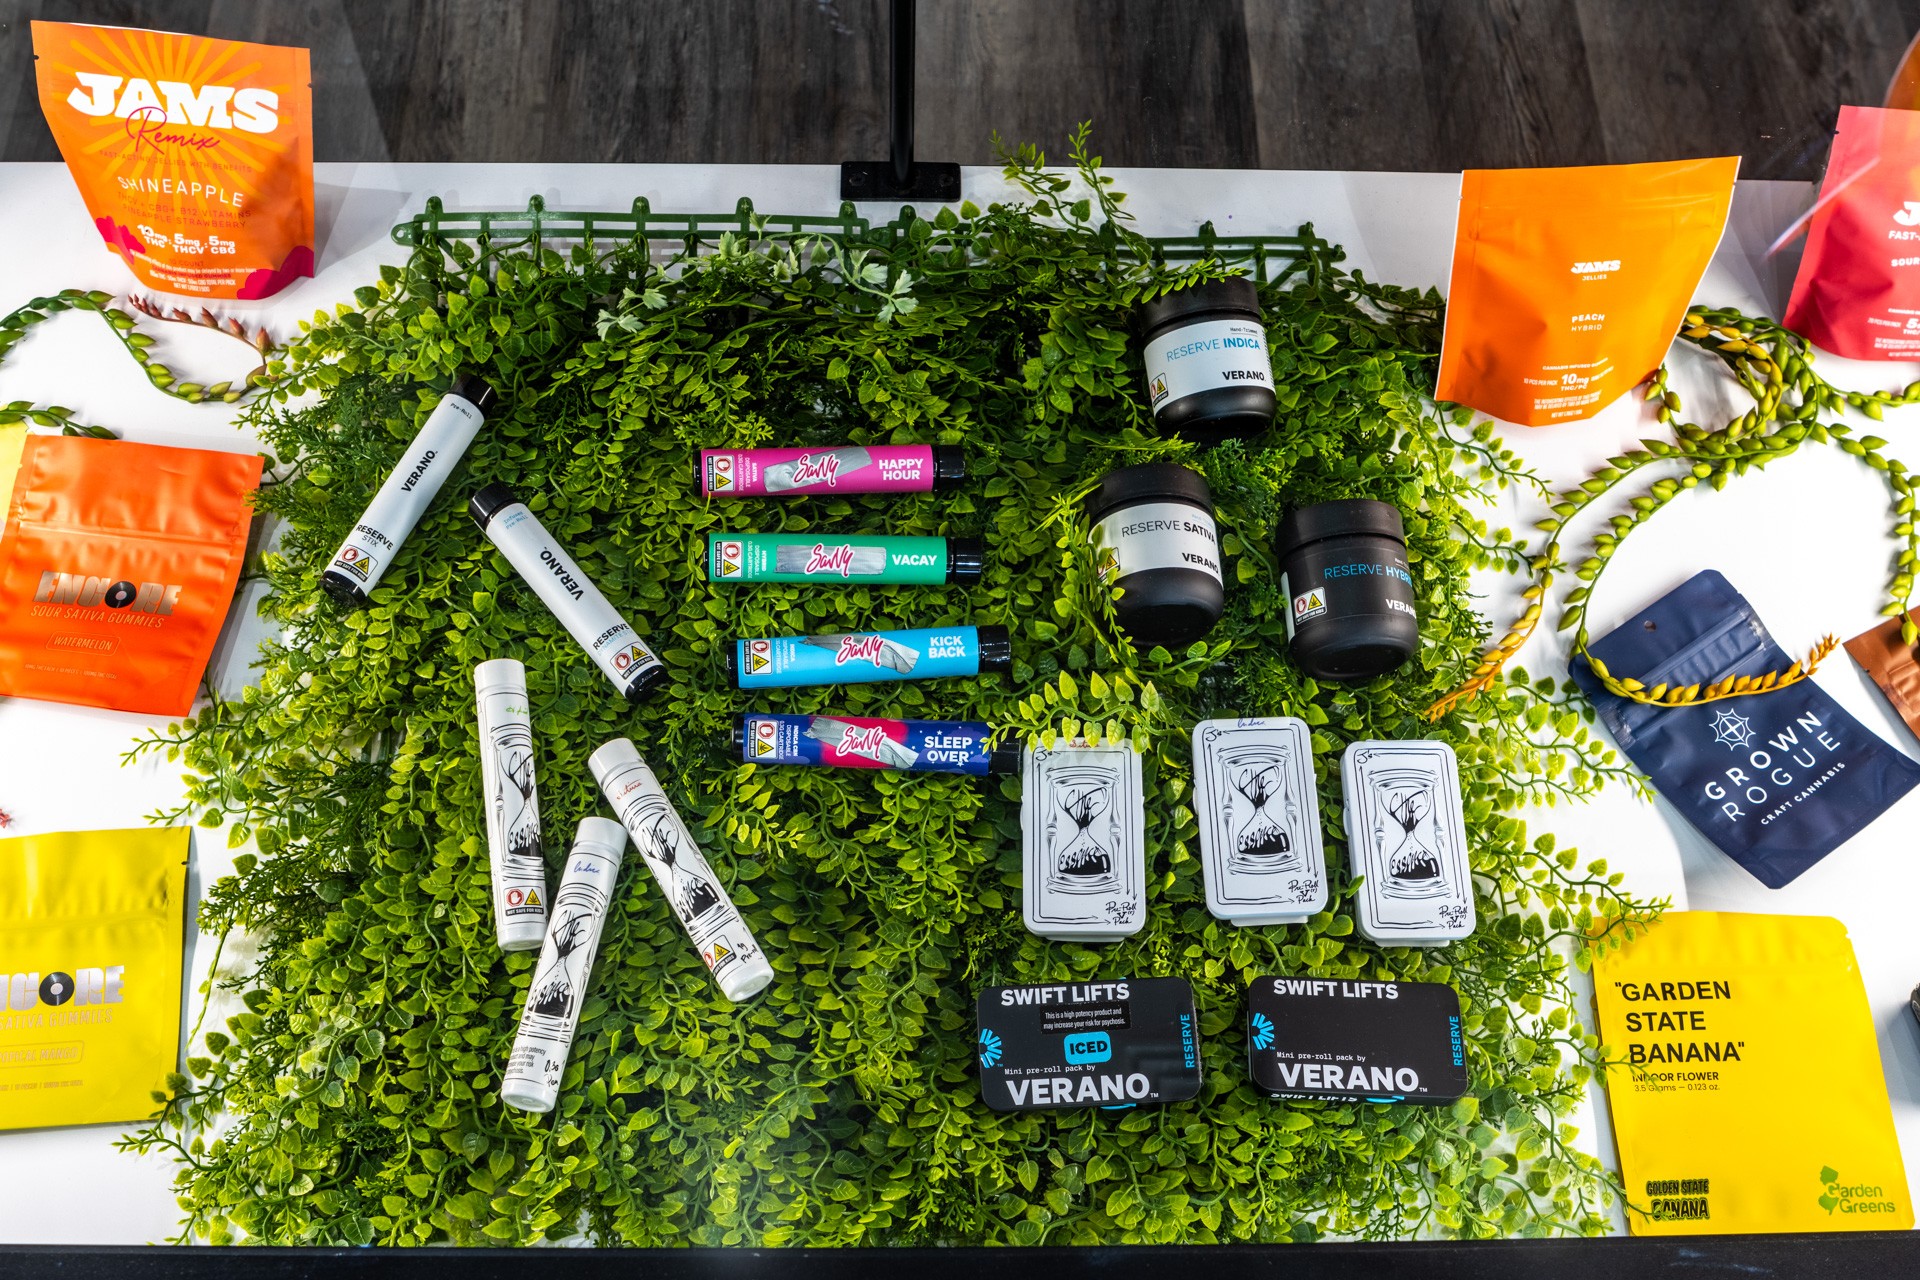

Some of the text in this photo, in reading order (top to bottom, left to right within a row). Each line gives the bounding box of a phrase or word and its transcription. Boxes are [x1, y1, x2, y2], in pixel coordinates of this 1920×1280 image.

[67, 71, 279, 134] JAMS
[126, 106, 221, 155] Remix
[212, 163, 252, 173] BENEFITS
[117, 176, 244, 208] SHINEAPPLE
[123, 203, 246, 229] PINEAPPLE STRAWBERRY
[180, 207, 198, 216] B12
[202, 209, 252, 219] VITAMINS
[144, 235, 166, 248] THC
[172, 244, 205, 254] THCV
[174, 233, 200, 247] 5mg
[209, 235, 235, 248] 5mg
[1571, 260, 1621, 274] JAMS
[1572, 313, 1605, 323] PEACH
[1166, 337, 1260, 362] RESERVE INDICA
[1561, 373, 1589, 386] 10mg
[879, 458, 923, 471] HAPPY
[883, 470, 920, 481] HOUR
[356, 524, 394, 551] RESERVE
[1121, 520, 1181, 538] RESERVE
[1184, 521, 1216, 545] SATIVA
[361, 535, 379, 547] STIX
[892, 554, 937, 567] VACAY
[1324, 563, 1383, 580] RESERVE
[33, 570, 182, 615] ENCORE
[31, 605, 164, 628] SOUR SATIVA GUMMIES
[54, 636, 113, 651] WATERMELON
[592, 623, 630, 651] RESERVE
[930, 635, 962, 647] KICK
[928, 646, 966, 658] BACK
[924, 736, 973, 750] SLEEP
[927, 750, 969, 763] OVER
[1704, 710, 1822, 800] GROWN
[1721, 731, 1841, 822] ROGUE
[1760, 761, 1846, 825] CRAFT CANNABIS
[1296, 894, 1316, 904] Pack
[1112, 916, 1132, 926] Pack
[1446, 920, 1465, 930] Pack
[1001, 983, 1130, 1006] SWIFT LIFTS
[1273, 979, 1399, 999] SWIFT LIFTS
[1614, 980, 1731, 1002] "GARDEN
[49, 1008, 113, 1027] GUMMIES
[1064, 1011, 1074, 1019] high
[1075, 1010, 1093, 1019] potency
[1094, 1008, 1112, 1017] product
[1113, 1007, 1122, 1015] and
[1102, 1018, 1125, 1027] psychosis.
[1626, 1010, 1706, 1032] STATE
[1069, 1041, 1108, 1055] ICED
[1180, 1013, 1195, 1069] RESERVE
[1449, 1015, 1463, 1067] RESERVE
[40, 1047, 79, 1061] MANGO
[528, 1046, 547, 1056] potency
[1276, 1051, 1366, 1062] Mini pre-roll pack by
[1629, 1041, 1745, 1064] BANANA"
[1026, 1066, 1061, 1075] pre-roll
[1065, 1064, 1083, 1073] pack
[1086, 1064, 1096, 1072] by
[1677, 1071, 1719, 1081] FLOWER
[1277, 1063, 1419, 1092] VERANO
[1005, 1072, 1150, 1106] VERANO
[1635, 1084, 1646, 1092] 3.5
[1687, 1083, 1707, 1091] 0.123
[1646, 1178, 1709, 1197] GOLDEN STATE
[1825, 1182, 1883, 1199] Garden
[1839, 1198, 1896, 1213] Greens
